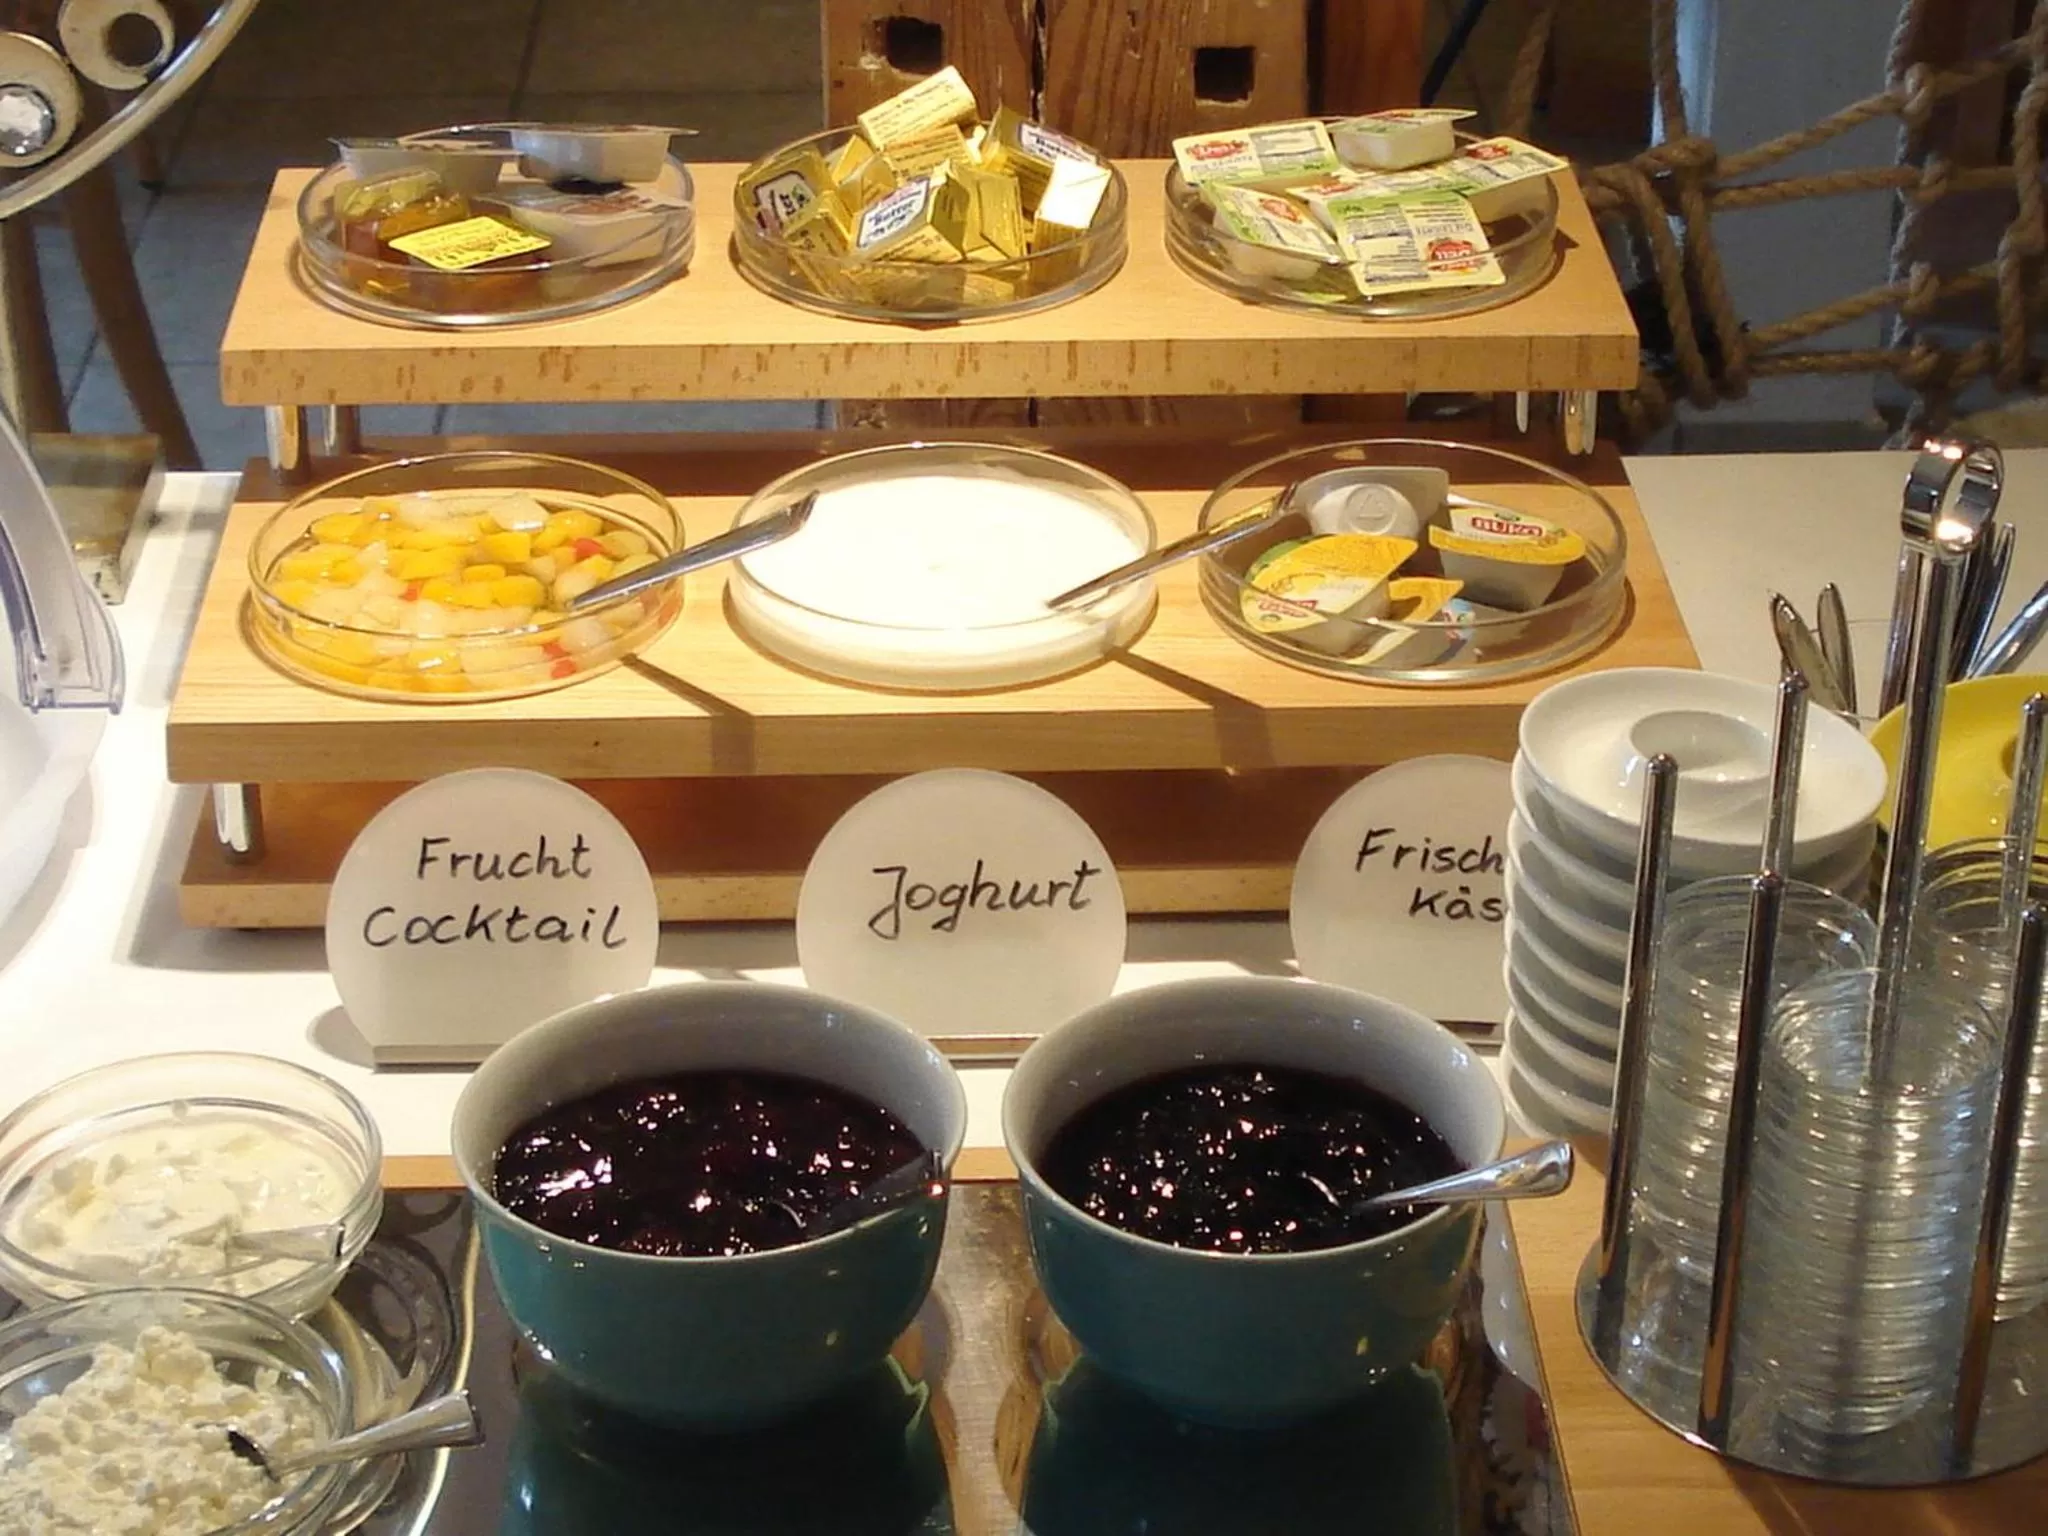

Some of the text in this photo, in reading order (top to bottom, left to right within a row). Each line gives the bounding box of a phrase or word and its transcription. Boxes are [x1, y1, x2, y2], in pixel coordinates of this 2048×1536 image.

[416, 833, 593, 881] Frucht
[1354, 827, 1504, 874] Frisch
[867, 858, 1103, 941] Joghurt
[362, 903, 628, 950] Cocktail
